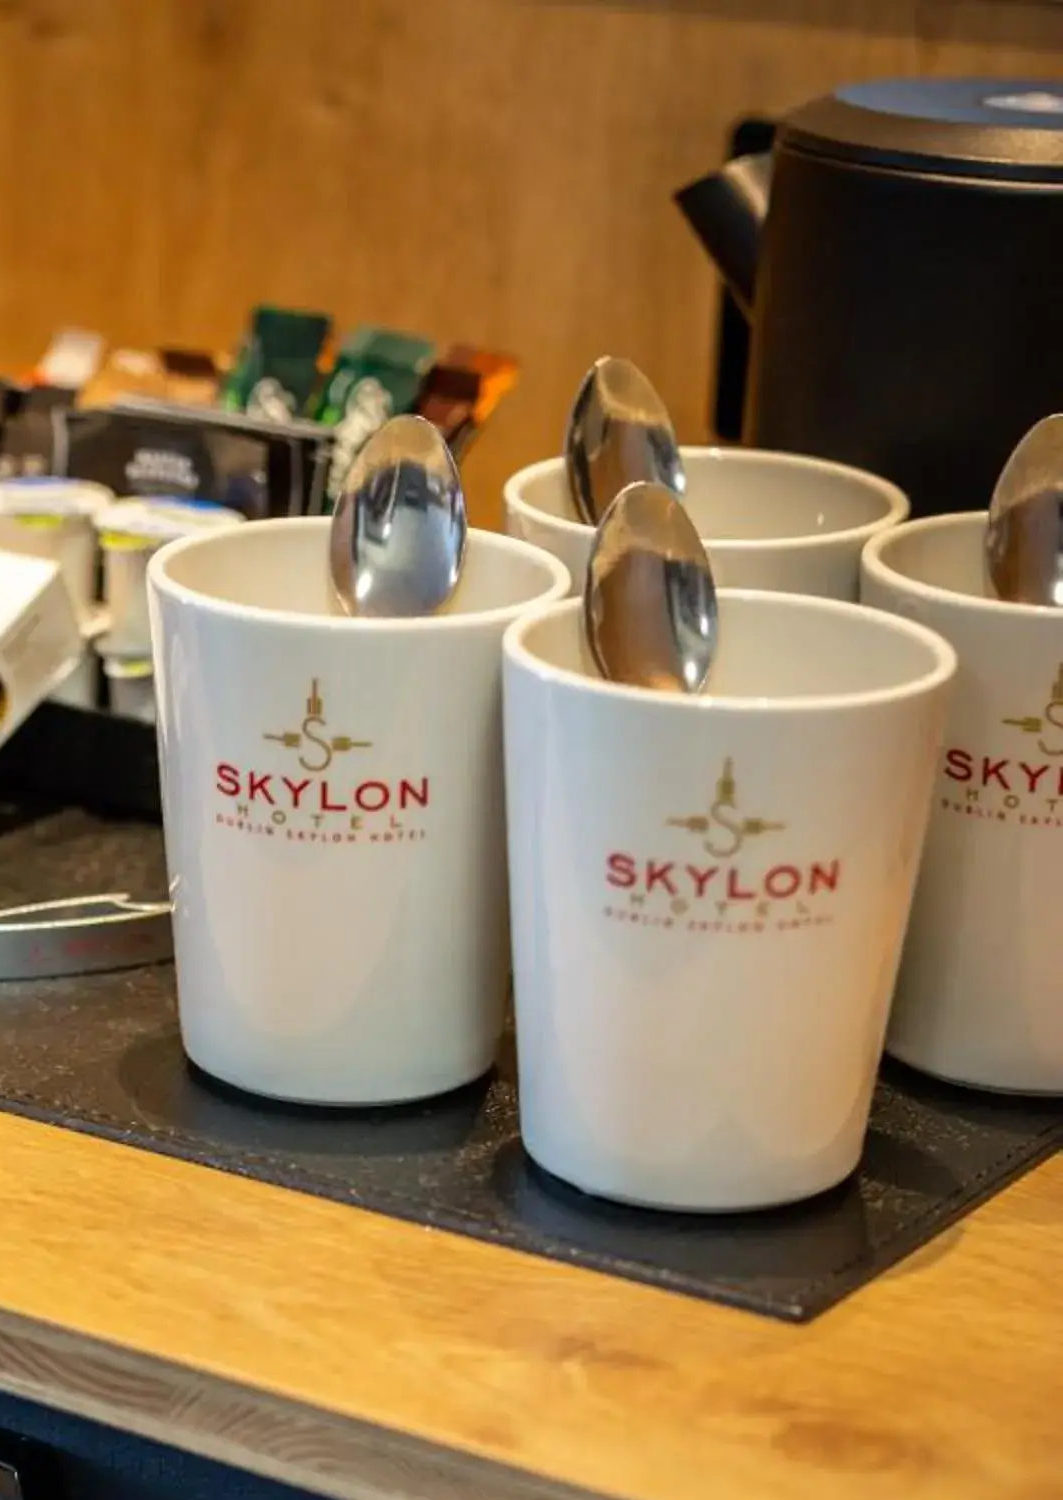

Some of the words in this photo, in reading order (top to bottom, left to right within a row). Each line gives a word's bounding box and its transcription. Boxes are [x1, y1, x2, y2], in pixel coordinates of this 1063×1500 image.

[216, 763, 429, 812] SKYLON
[237, 804, 402, 830] HOTEL
[606, 852, 841, 901] SKYLON
